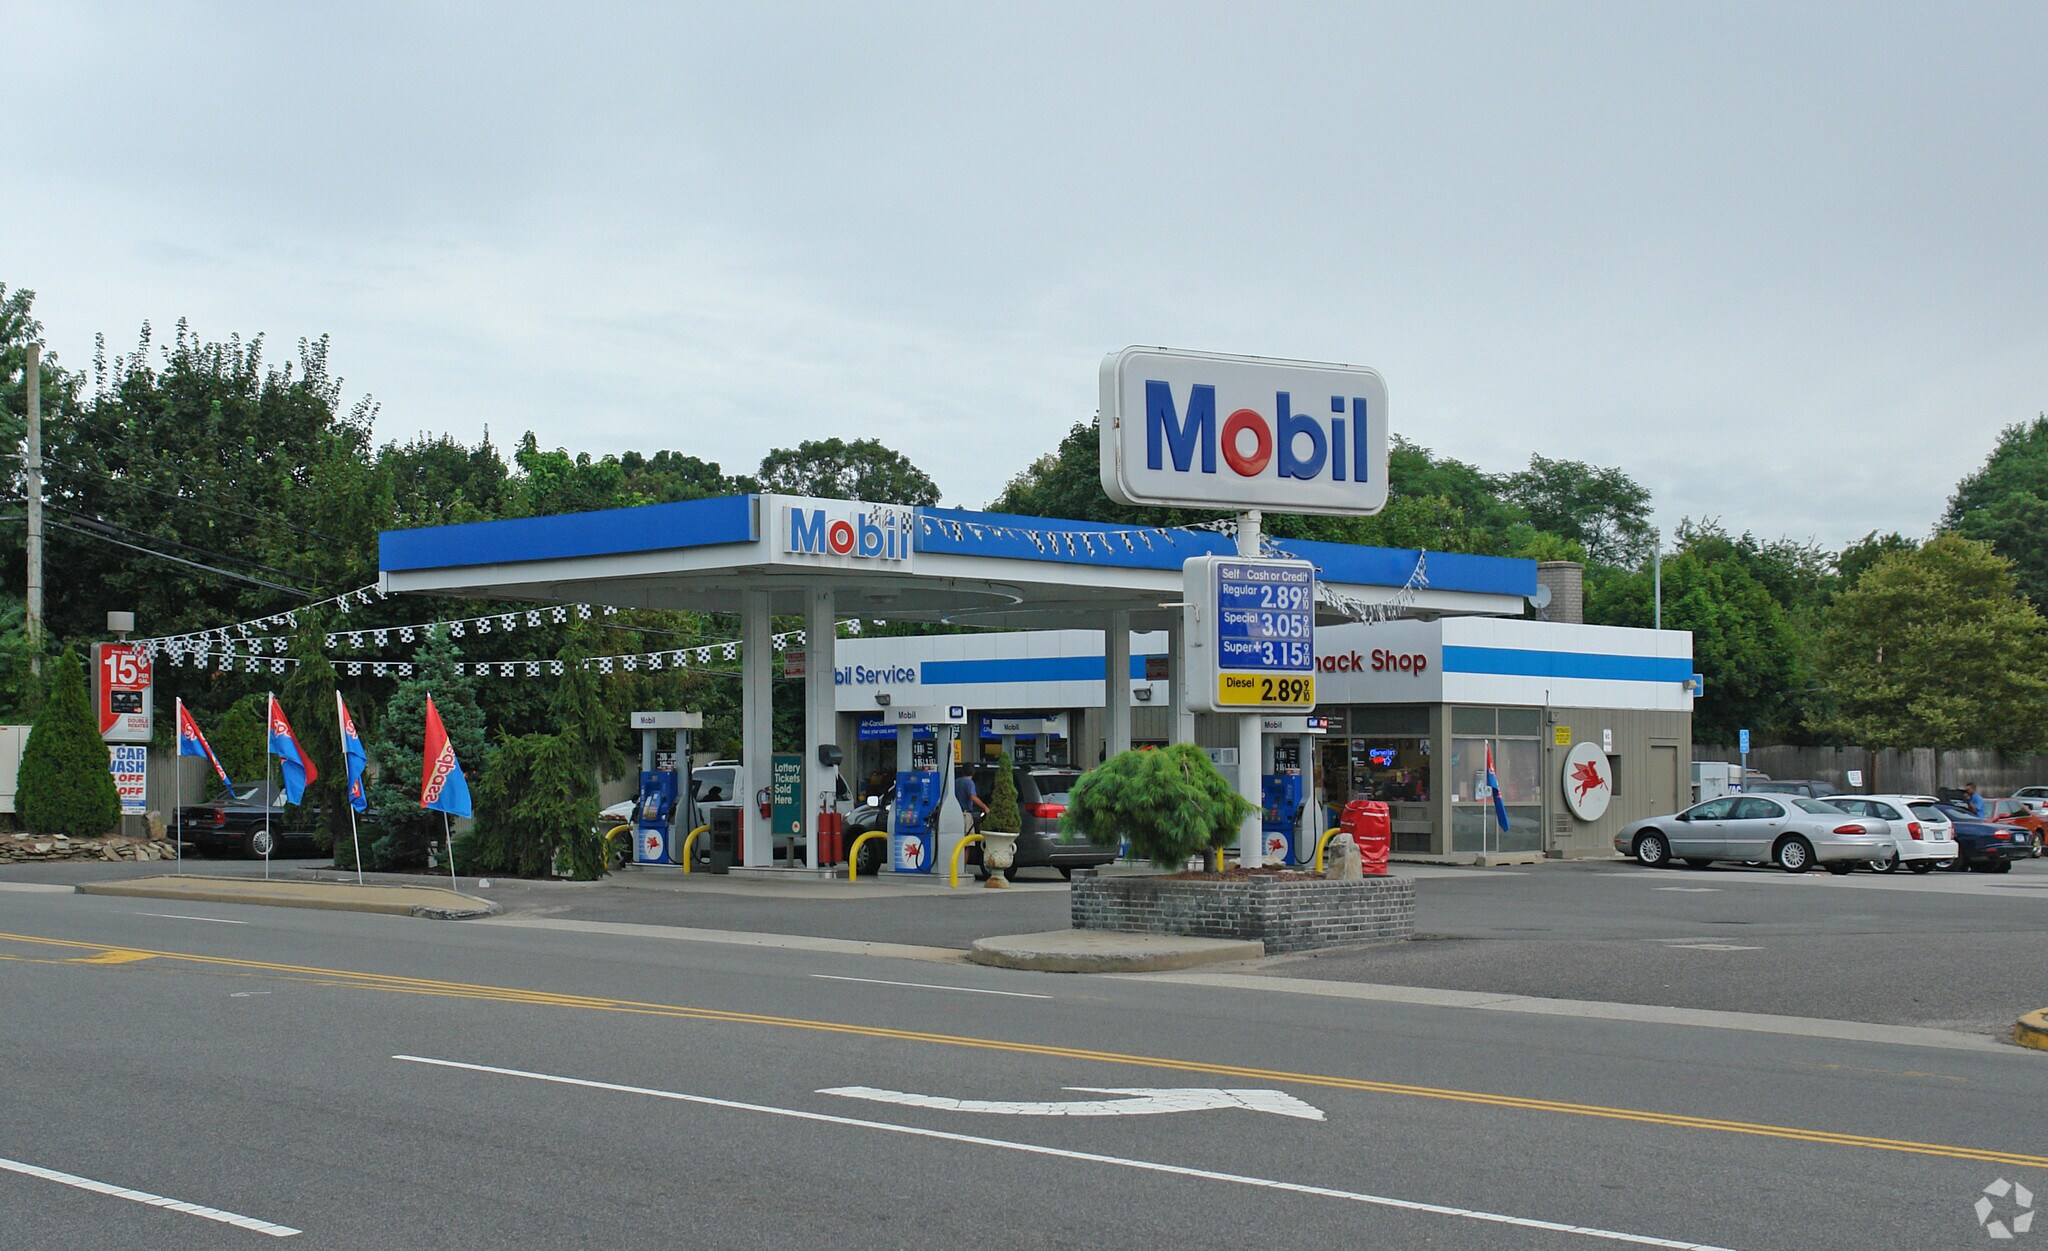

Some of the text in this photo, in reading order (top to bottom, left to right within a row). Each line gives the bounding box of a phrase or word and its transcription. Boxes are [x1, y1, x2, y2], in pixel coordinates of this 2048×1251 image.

[1146, 379, 1367, 482] Mobil
[790, 507, 908, 560] Mobil
[1222, 568, 1308, 582] Self Cash or Credit
[1222, 583, 1257, 597] Regular
[1261, 585, 1302, 610] 2.89
[1224, 612, 1258, 625] Special
[1261, 613, 1302, 638] 3.05
[1262, 641, 1303, 666] 3.15
[1315, 648, 1427, 676] nack Shop
[835, 664, 915, 685] bil Service
[1226, 677, 1255, 688] Diesel
[1261, 678, 1303, 702] 2.89
[640, 716, 656, 724] Mobil
[898, 710, 916, 719] Mobil
[1004, 723, 1020, 731] Mobil
[1264, 721, 1282, 729] Mobil
[116, 747, 145, 760] CAR
[774, 762, 800, 774] Lottery
[118, 774, 144, 782] OFF
[774, 774, 800, 783] Tickets
[118, 787, 144, 795] OFF
[774, 784, 792, 794] Sold
[774, 794, 792, 805] Here
